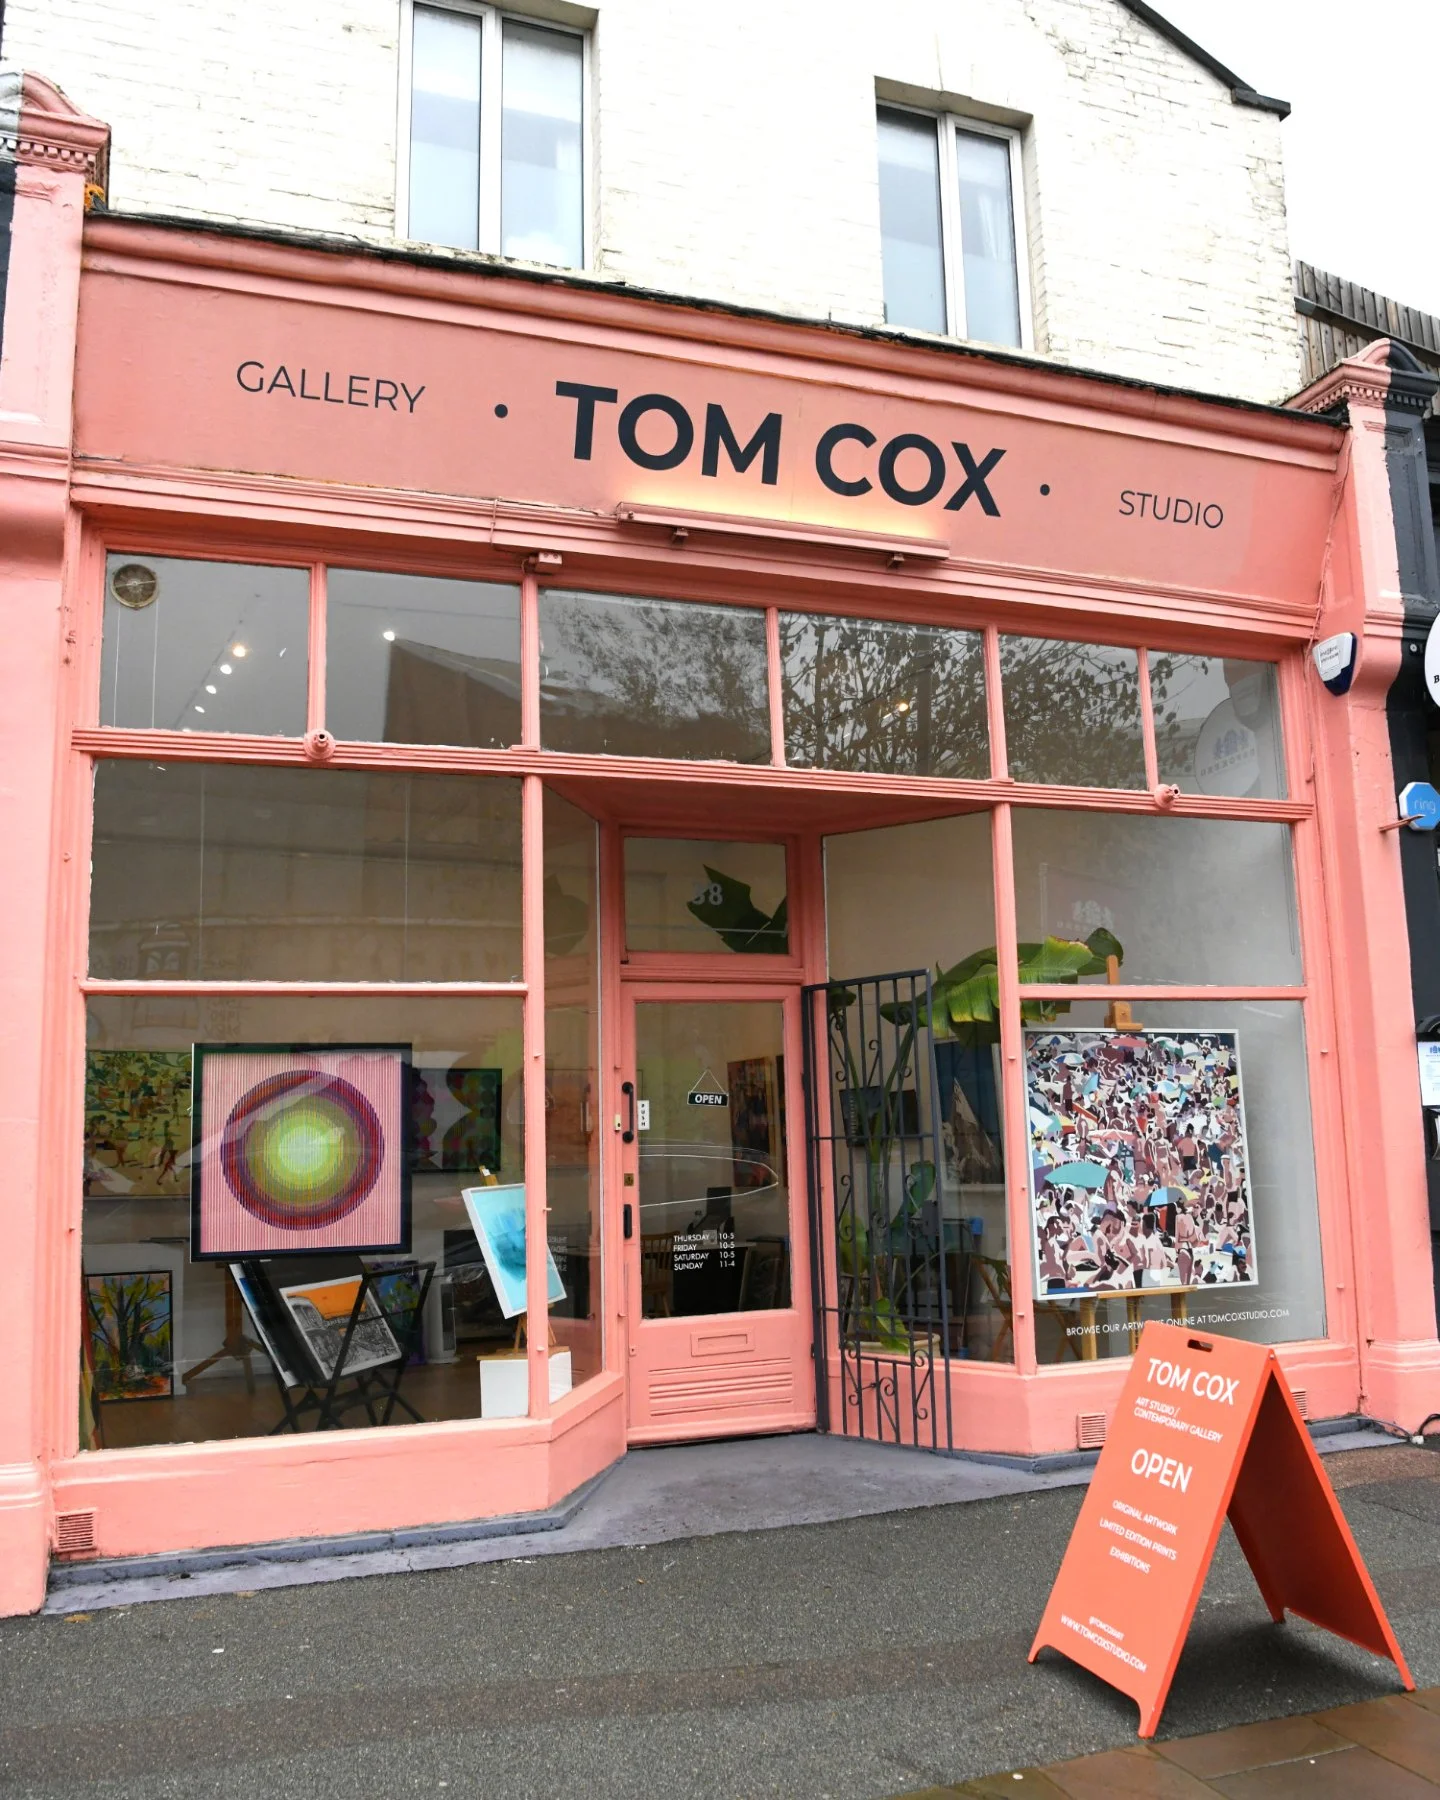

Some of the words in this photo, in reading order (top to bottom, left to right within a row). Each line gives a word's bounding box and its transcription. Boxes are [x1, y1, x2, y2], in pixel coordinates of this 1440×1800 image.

[236, 360, 426, 414] GALLERY
[555, 380, 783, 486] TOM
[815, 422, 1007, 518] COX
[1118, 489, 1224, 529] STUDIO
[1414, 798, 1436, 815] ring
[694, 1093, 723, 1105] OPEN
[673, 1233, 711, 1242] THURSDAY
[719, 1232, 735, 1240] 10-5
[673, 1243, 698, 1252] FRIDAY
[719, 1241, 736, 1249] 10-5
[673, 1252, 710, 1262] SATURDAY
[719, 1251, 736, 1259] 10-5
[674, 1261, 704, 1271] SUNDAY
[719, 1260, 736, 1268] 11-4
[1066, 1324, 1101, 1336] BROWSE
[1102, 1323, 1121, 1334] OUR
[1166, 1316, 1195, 1327] ONLINE
[1196, 1315, 1207, 1325] AT
[1207, 1308, 1290, 1323] TOMCOXSTUDIO.COM
[1146, 1357, 1191, 1392] TOM
[1192, 1370, 1240, 1406] COX
[1135, 1396, 1151, 1408] ART
[1149, 1399, 1175, 1416] STUDIO
[1133, 1406, 1191, 1432] CONTEMPORARY
[1189, 1424, 1224, 1443] GALLERY
[1131, 1448, 1193, 1494] OPEN
[1112, 1499, 1143, 1521] ORIGINAL
[1143, 1513, 1179, 1536] ARTWORK
[1099, 1517, 1126, 1536] LIMITED
[1124, 1528, 1154, 1550] EDITION
[1151, 1542, 1178, 1561] PRINTS
[1109, 1545, 1151, 1574] EXHIBITIONS
[1061, 1613, 1148, 1673] WWW.TOMCOXSTUDIO.COM
